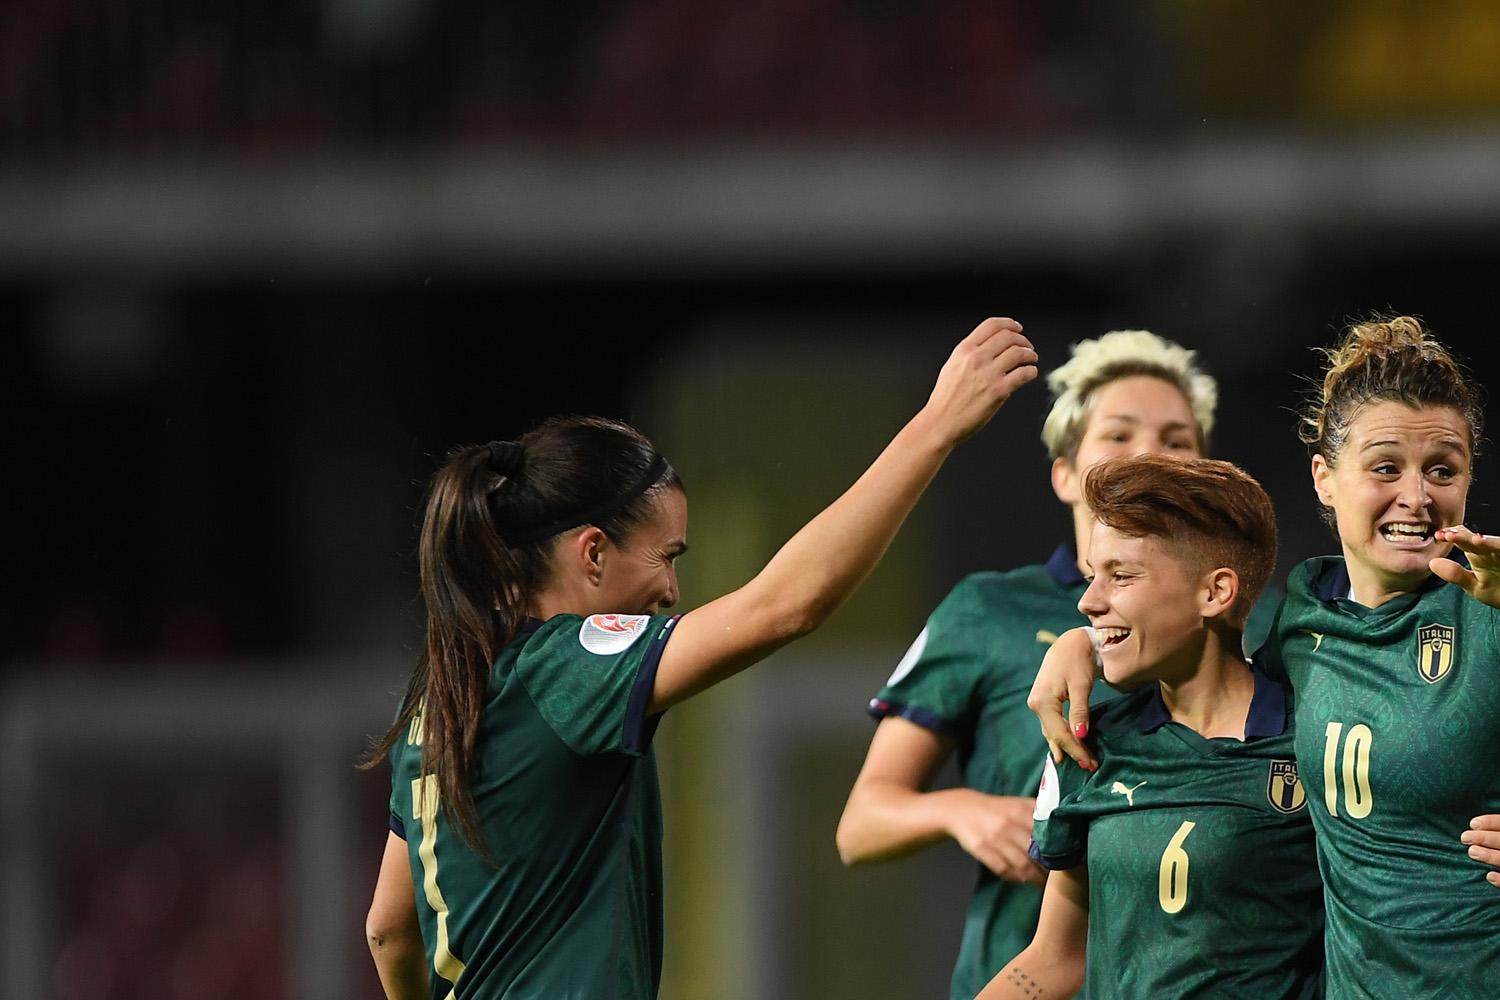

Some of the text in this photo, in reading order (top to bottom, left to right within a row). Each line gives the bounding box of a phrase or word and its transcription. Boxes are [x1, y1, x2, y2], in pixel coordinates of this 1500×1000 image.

[1421, 629, 1452, 639] ITALIA
[1273, 763, 1298, 774] ITAL
[1323, 721, 1373, 819] 10
[1159, 821, 1196, 923] 6
